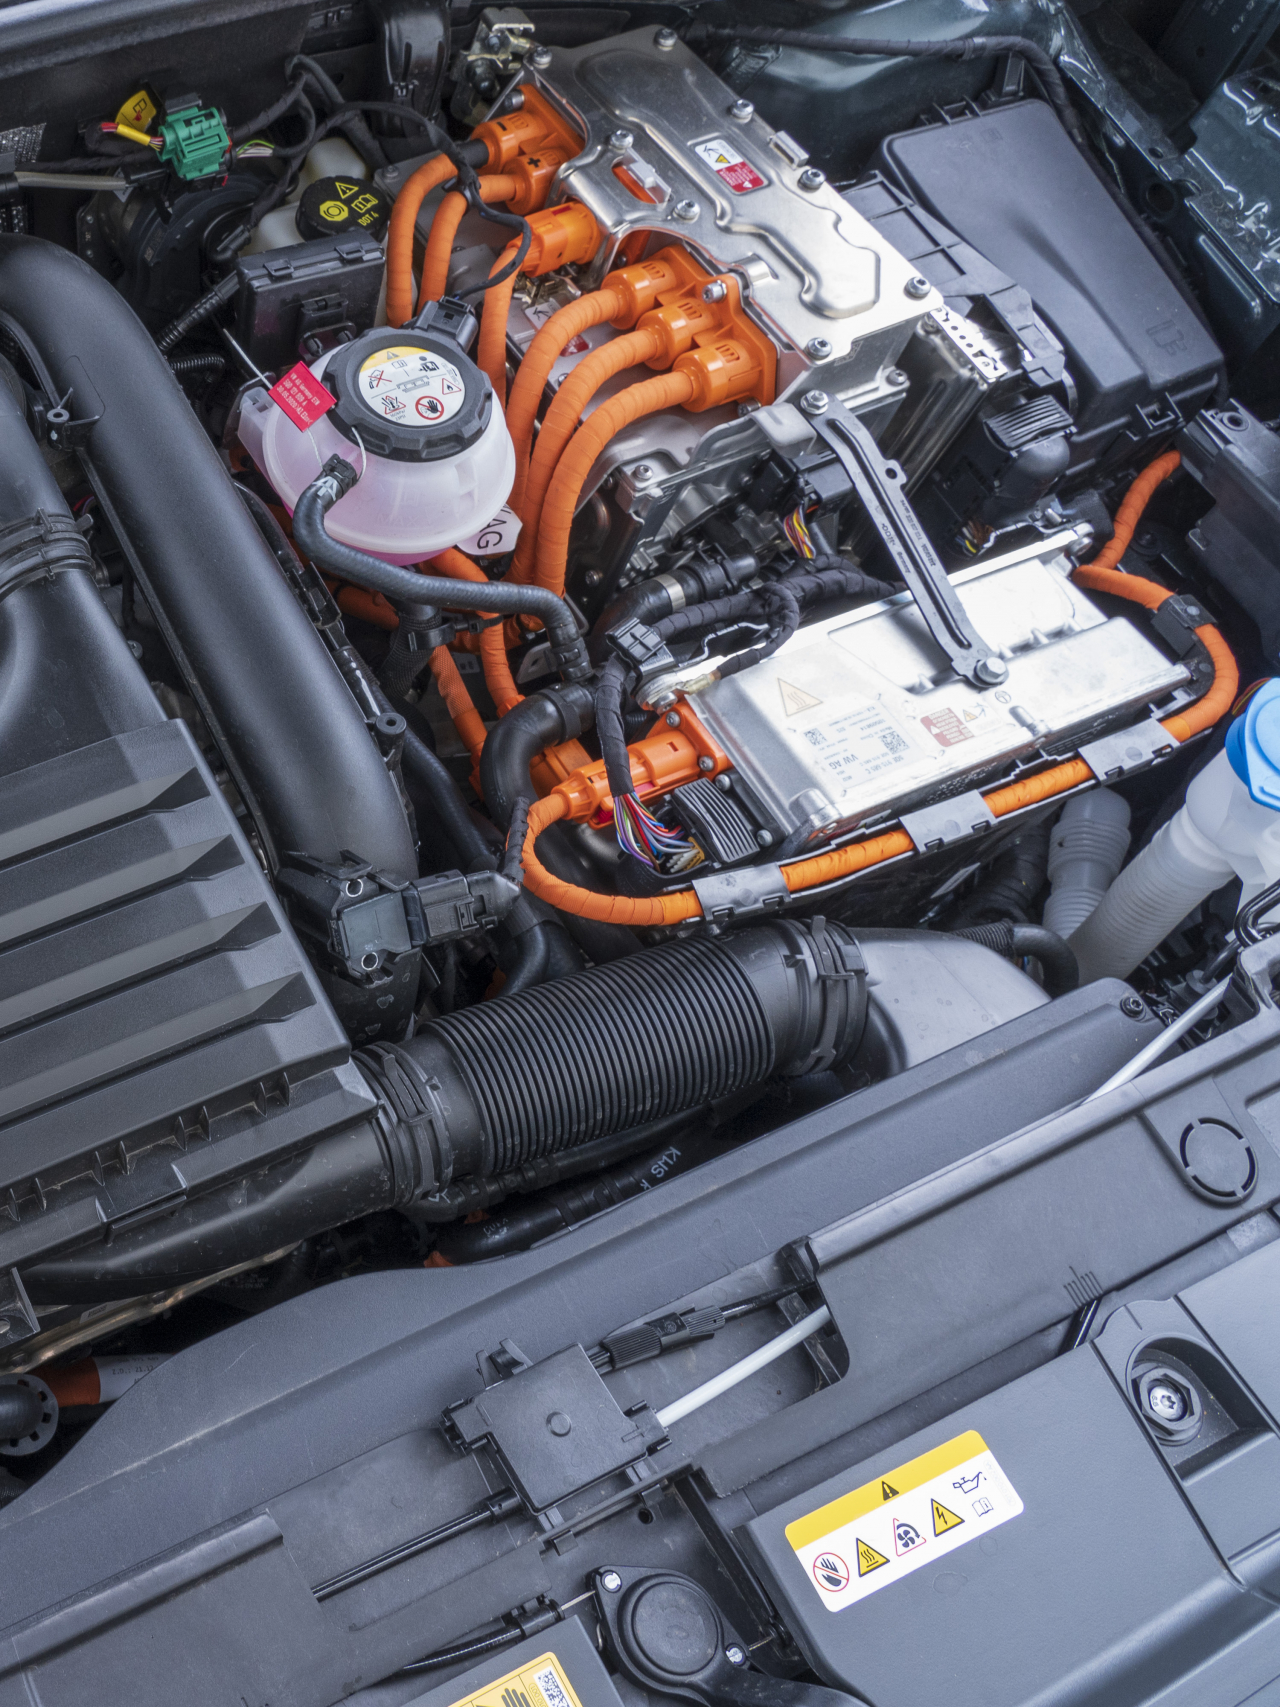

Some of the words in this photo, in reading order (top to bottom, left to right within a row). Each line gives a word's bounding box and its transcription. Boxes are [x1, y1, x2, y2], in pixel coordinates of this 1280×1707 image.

[356, 212, 373, 226] DOT
[298, 382, 313, 399] Germany
[301, 399, 308, 407] A
[827, 758, 842, 770] AG
[841, 752, 858, 765] VW
[864, 766, 871, 775] C
[650, 1146, 681, 1177] KWS
